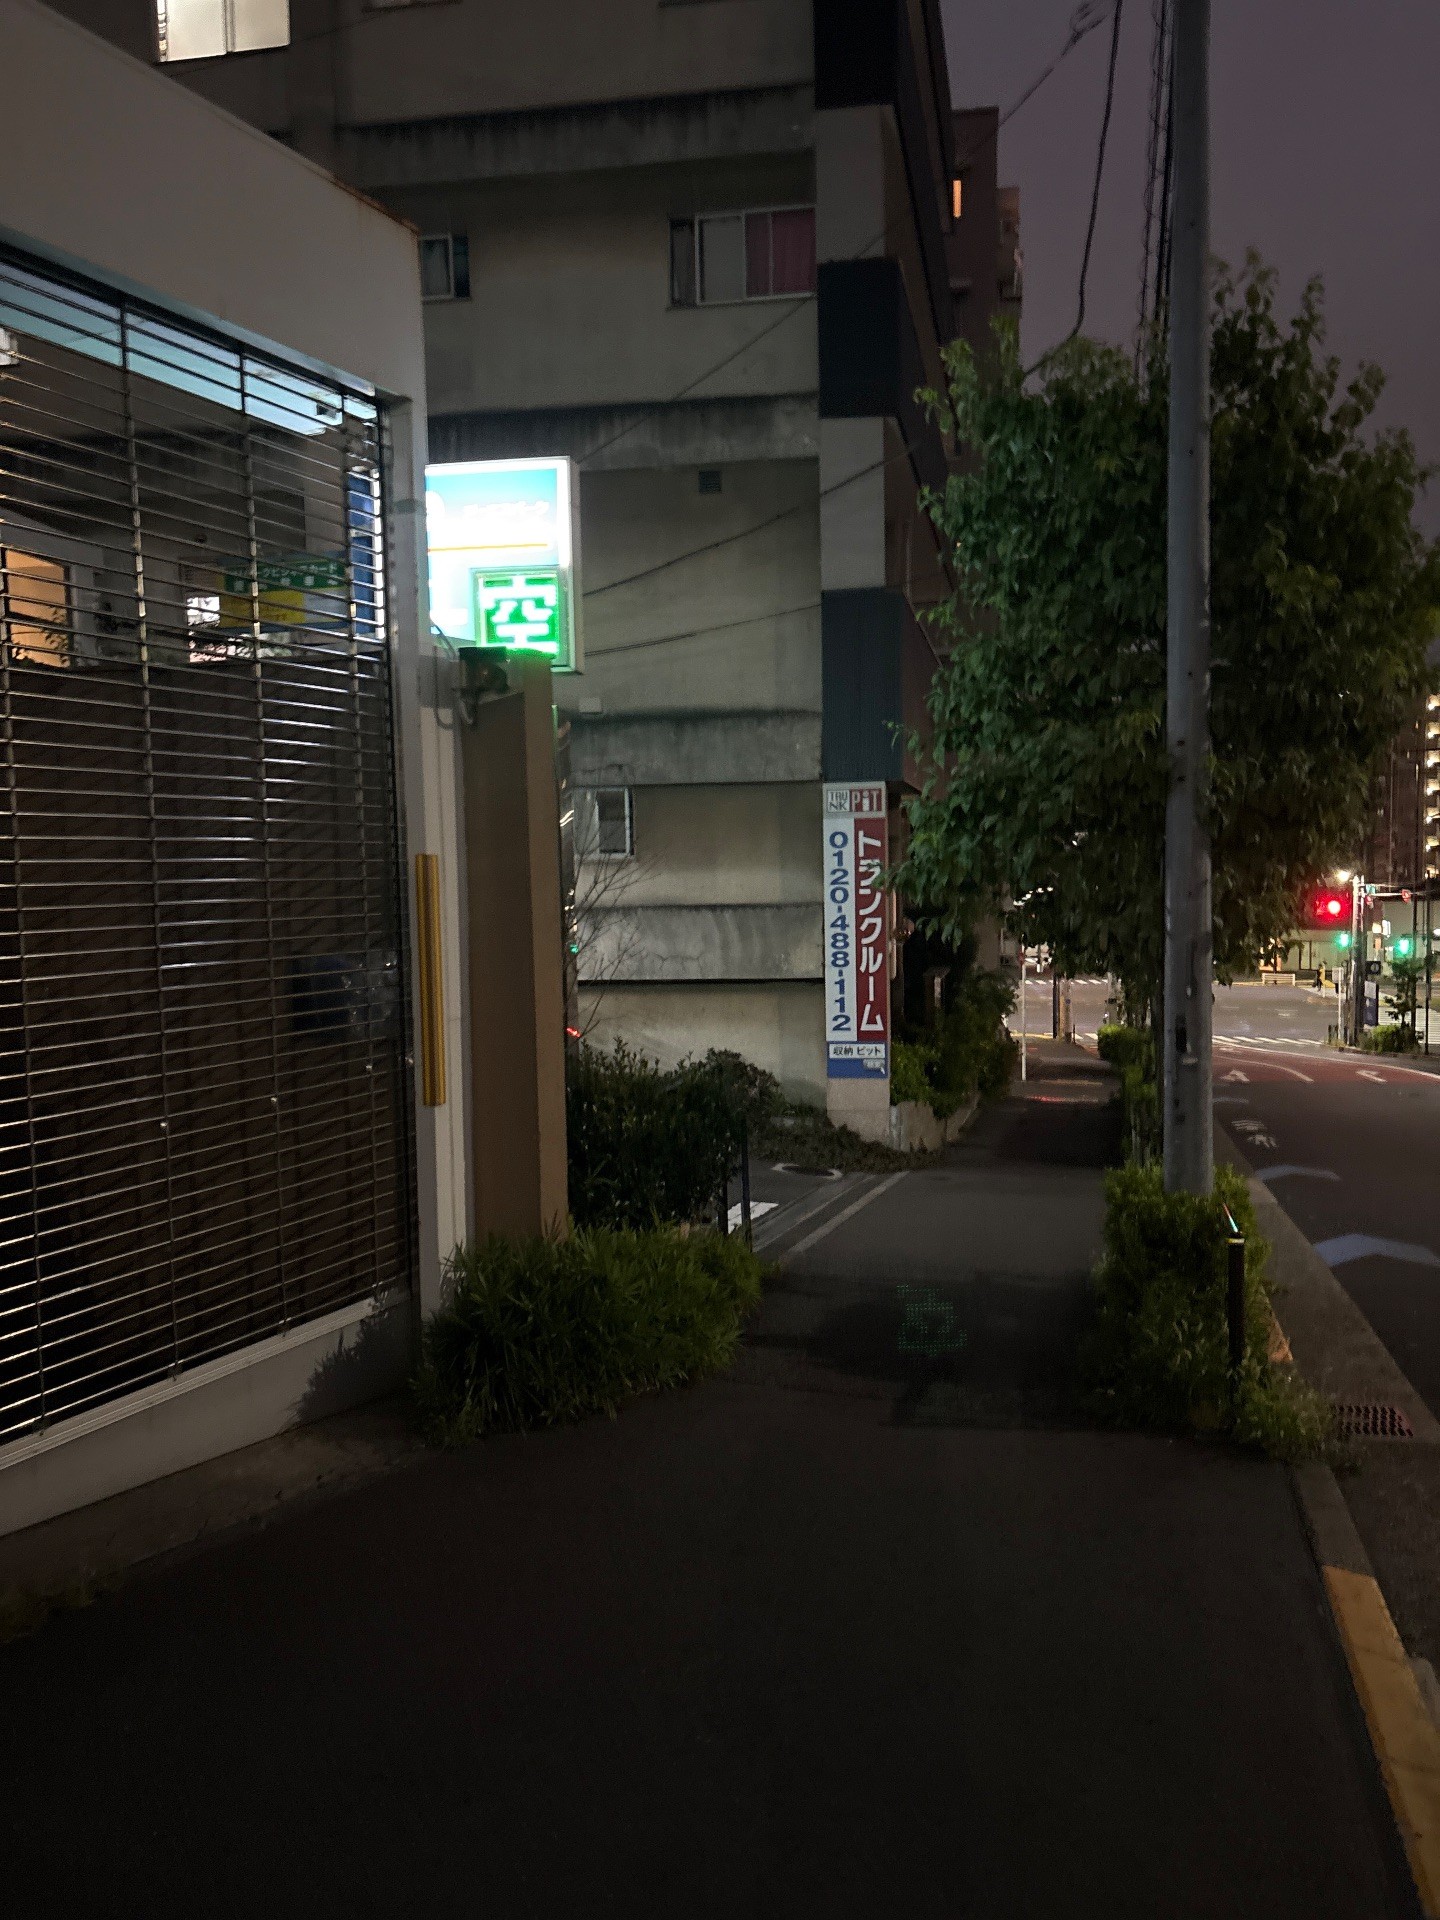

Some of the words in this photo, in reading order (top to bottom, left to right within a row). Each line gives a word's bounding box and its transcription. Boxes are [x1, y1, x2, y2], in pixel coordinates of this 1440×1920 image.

[480, 575, 558, 655] 空
[829, 831, 851, 1032] 0120-488-112
[858, 829, 884, 1031] トランクルーム
